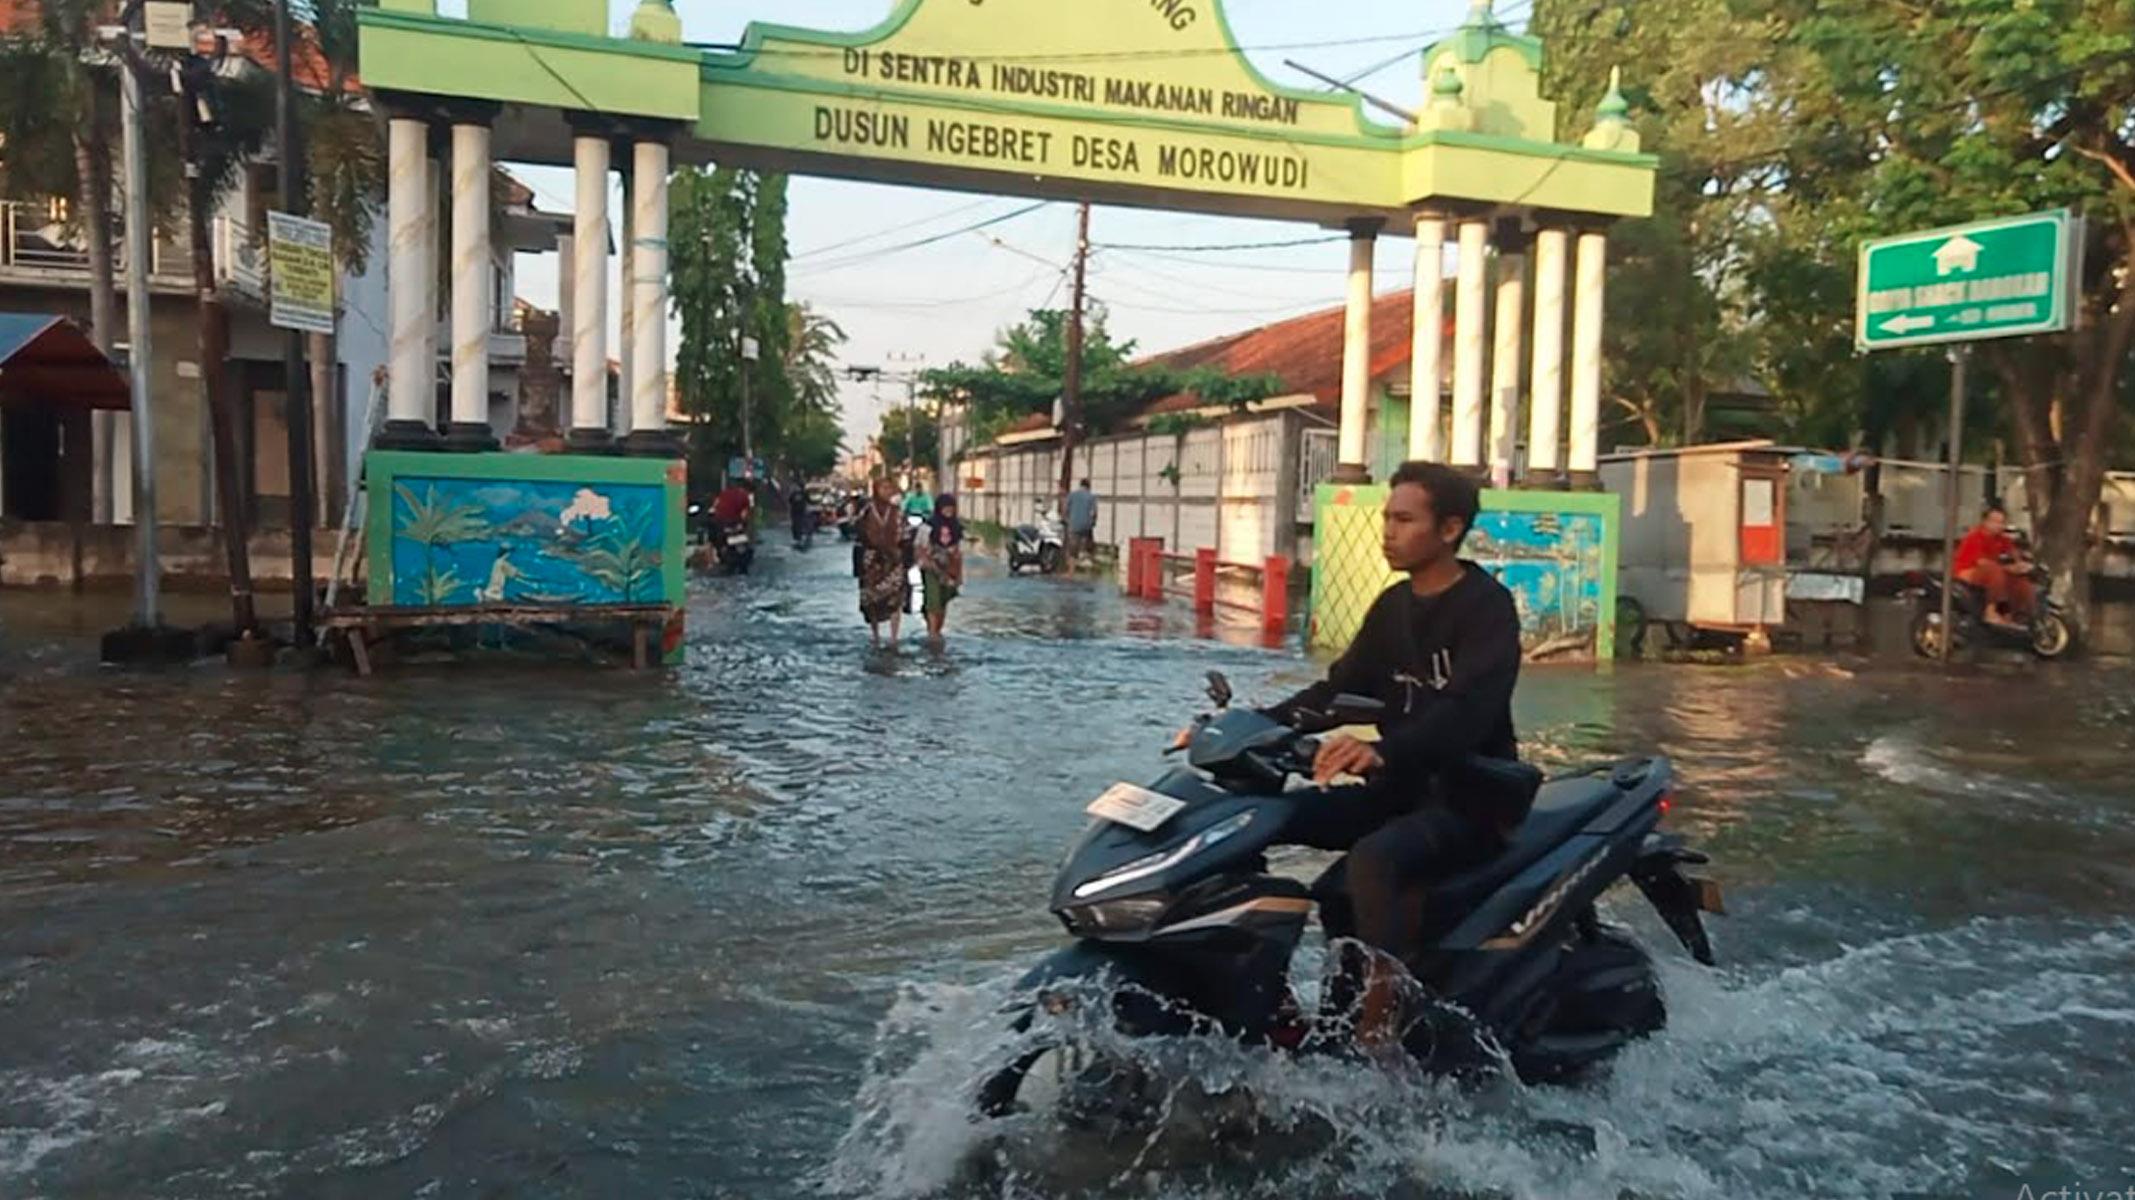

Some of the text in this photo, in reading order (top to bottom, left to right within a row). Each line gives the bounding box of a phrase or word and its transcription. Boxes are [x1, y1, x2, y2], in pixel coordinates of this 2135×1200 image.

[1151, 0, 1196, 31] NG
[844, 47, 1299, 125] DI SENTRA INDUSTRI MAKANAN RINGAN
[814, 106, 1308, 189] DUSUN NGEBRET DESA MOROWUDI
